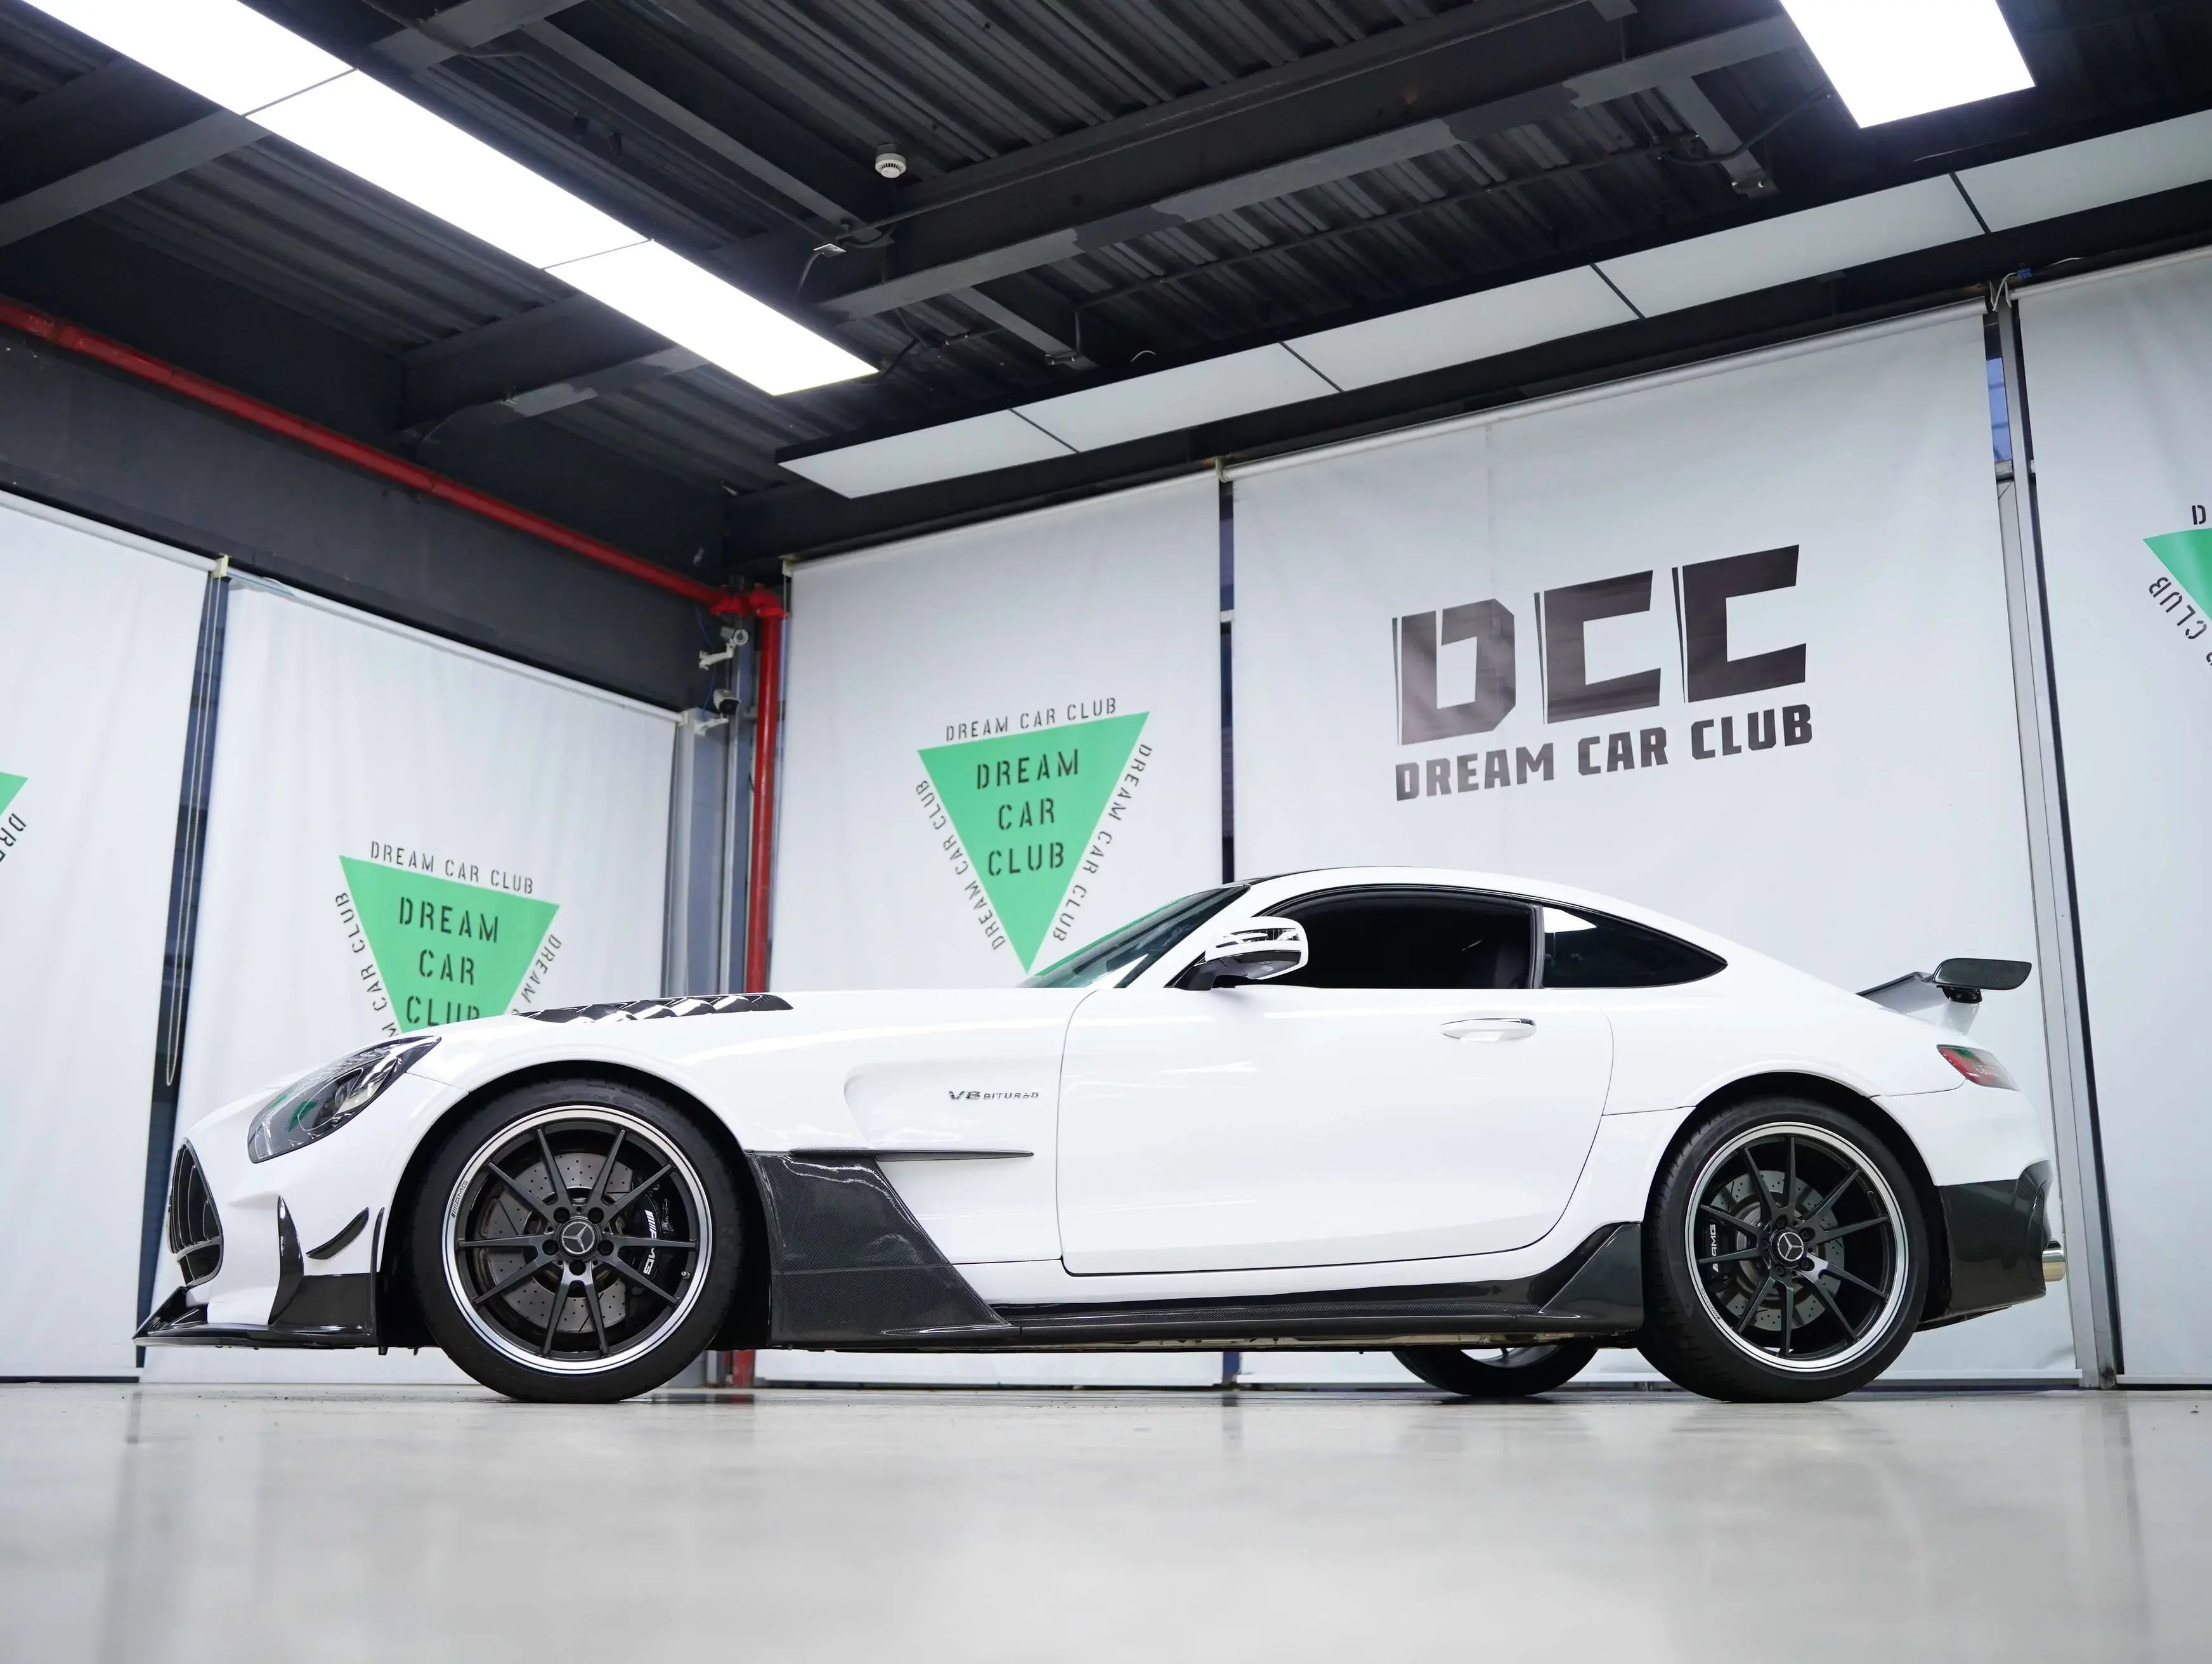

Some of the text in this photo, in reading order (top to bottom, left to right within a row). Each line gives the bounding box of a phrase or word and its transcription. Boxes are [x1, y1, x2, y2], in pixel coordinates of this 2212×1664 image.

[2149, 577, 2207, 640] CLUB
[1391, 543, 1807, 745] DCC
[947, 698, 1116, 741] DREAM CAR CLUB
[977, 749, 1078, 790] DREAM
[1395, 703, 1812, 802] DREAM CAR CLUB
[998, 798, 1054, 830] CAR
[916, 781, 1005, 950] DREAM CAR CLUB
[989, 842, 1064, 876] CLUB
[1053, 744, 1152, 941] DREAM CAR CLUB
[371, 842, 533, 894] DREAM CAR CLUB
[400, 897, 498, 943] DREAM
[335, 893, 387, 1011] CAR CLUB
[419, 949, 474, 985] CAR
[521, 935, 562, 1003] DREAM
[948, 1091, 980, 1100] V8
[1709, 1223, 1719, 1258] AMG
